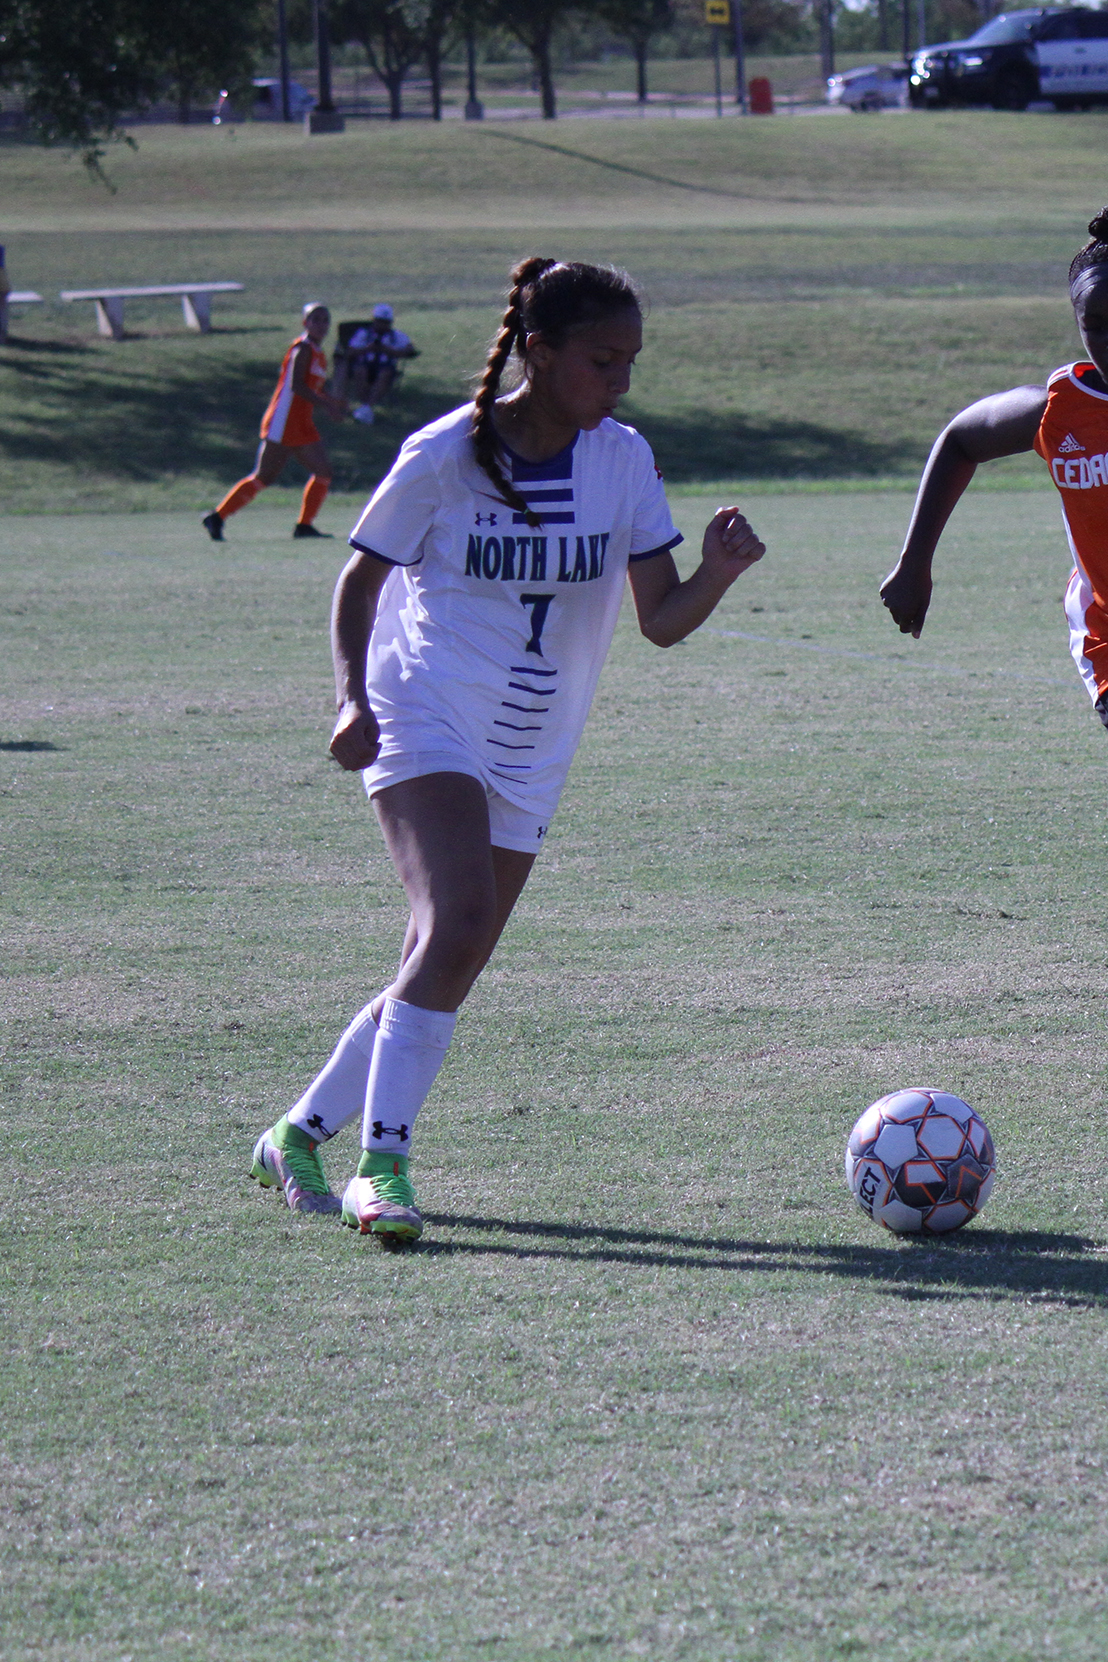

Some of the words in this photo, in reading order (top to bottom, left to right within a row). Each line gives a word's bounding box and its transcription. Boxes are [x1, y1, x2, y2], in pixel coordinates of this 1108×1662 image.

[464, 533, 548, 582] NORTH
[519, 593, 557, 658] 7
[860, 1166, 881, 1217] LECT
